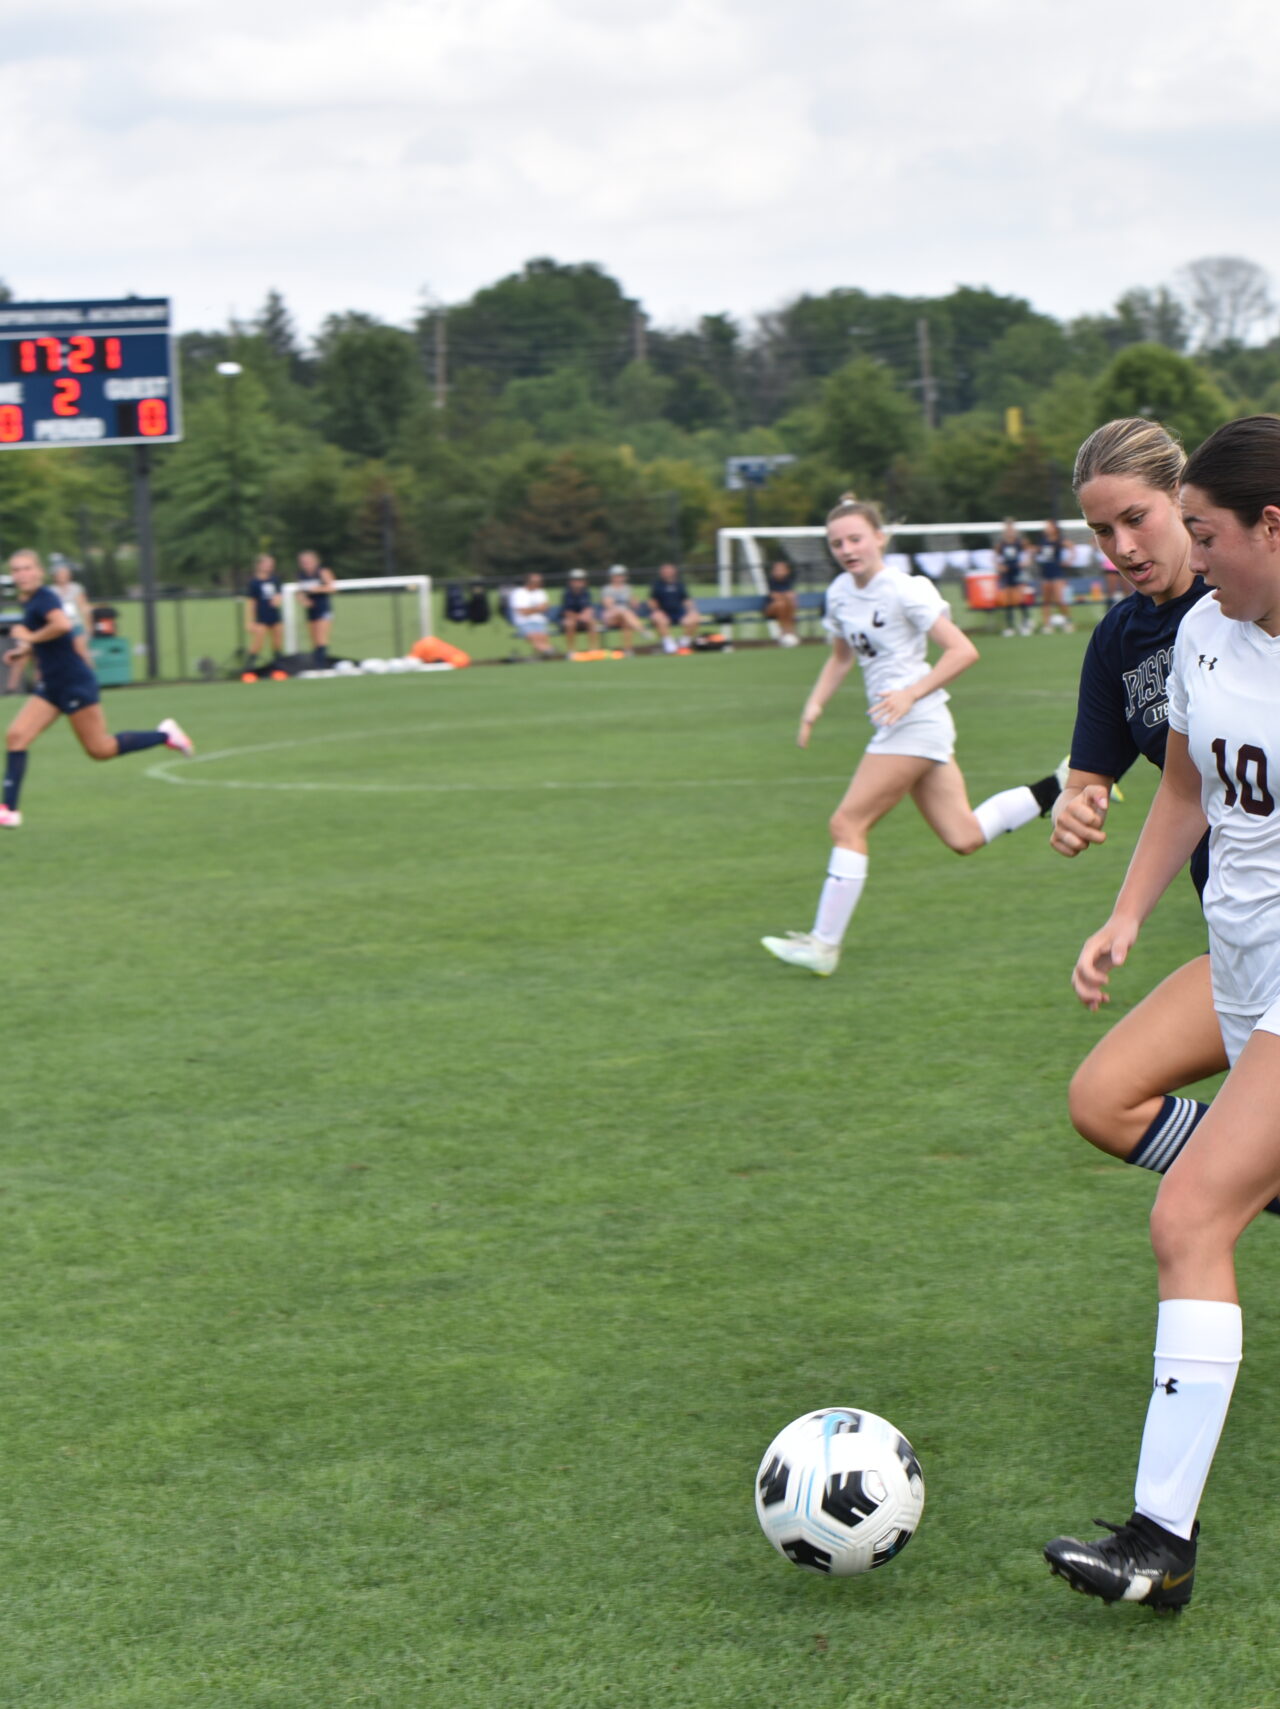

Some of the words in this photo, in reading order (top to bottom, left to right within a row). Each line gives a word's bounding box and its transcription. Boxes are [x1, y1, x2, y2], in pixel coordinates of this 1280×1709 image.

[52, 377, 81, 416] 2
[137, 398, 168, 436] 0
[1212, 737, 1275, 817] 10
